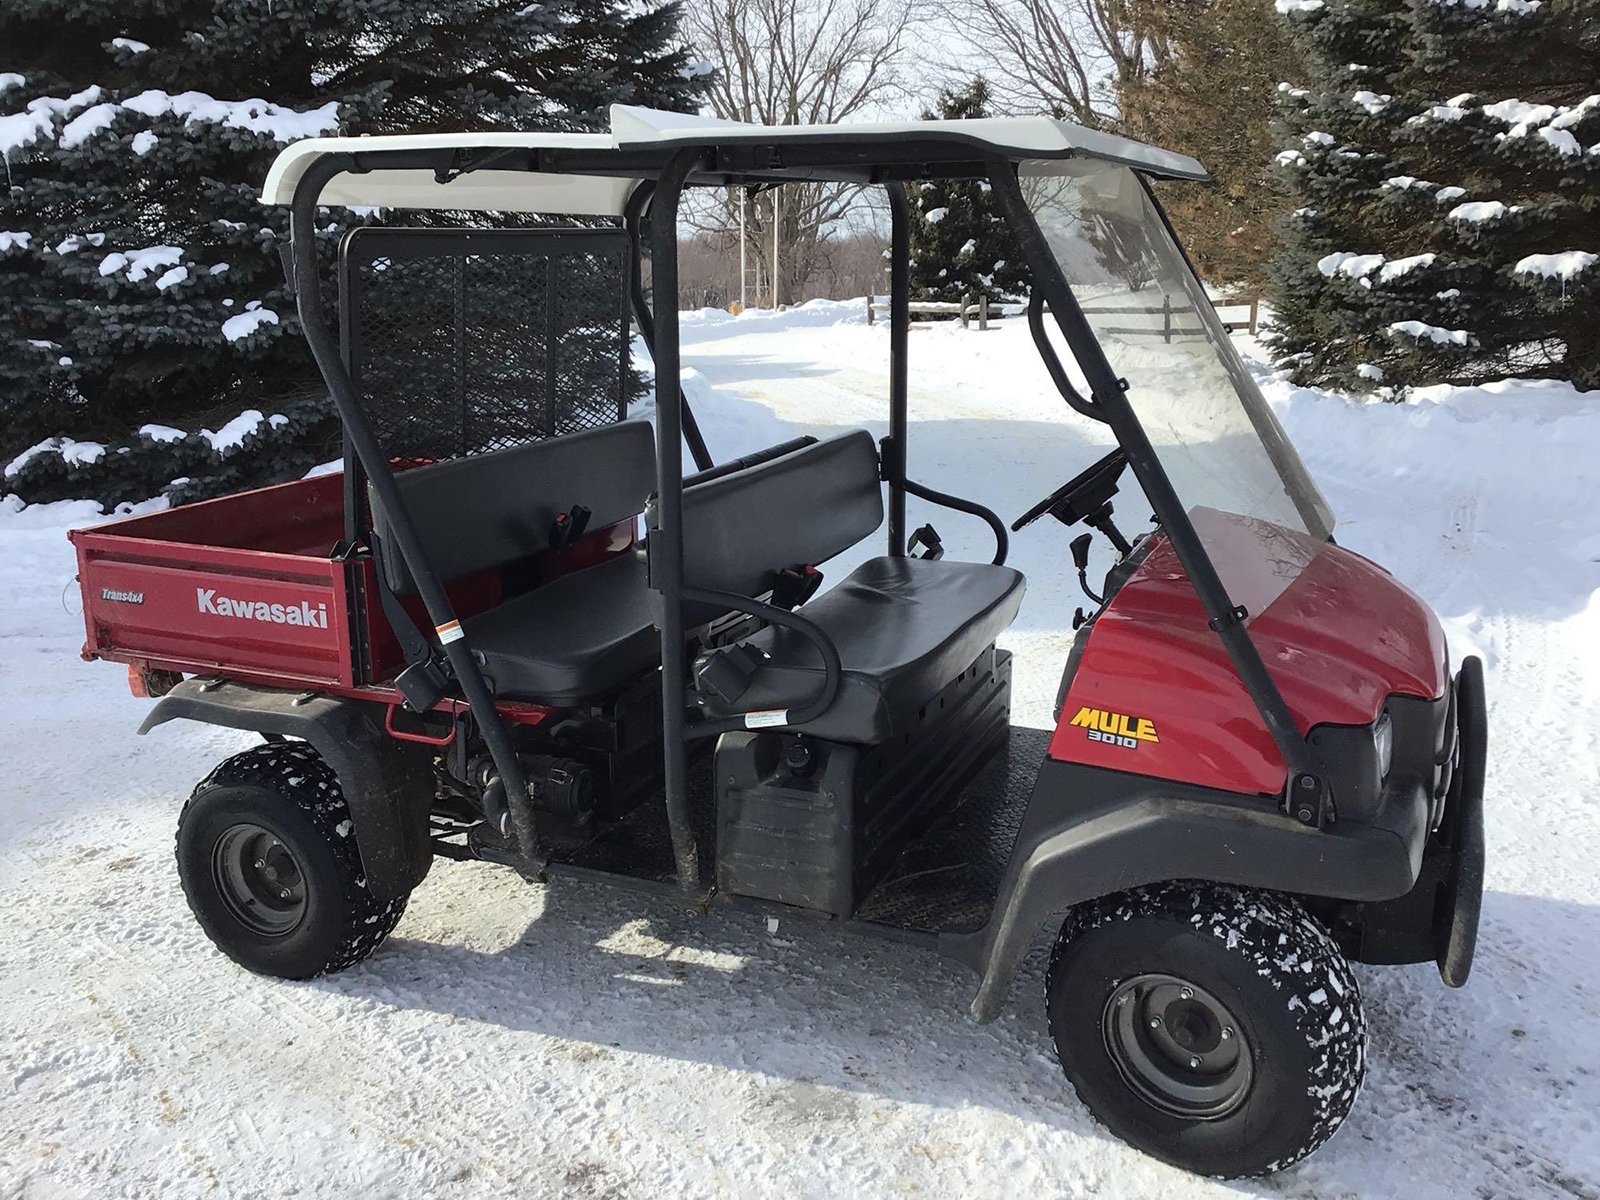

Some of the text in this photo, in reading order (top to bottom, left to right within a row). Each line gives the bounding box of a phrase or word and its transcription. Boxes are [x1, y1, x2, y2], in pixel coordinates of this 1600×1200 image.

[102, 588, 144, 604] Trans4x4
[197, 588, 328, 629] Kawasaki
[1070, 706, 1160, 743] MULE
[1087, 730, 1138, 749] 3010
